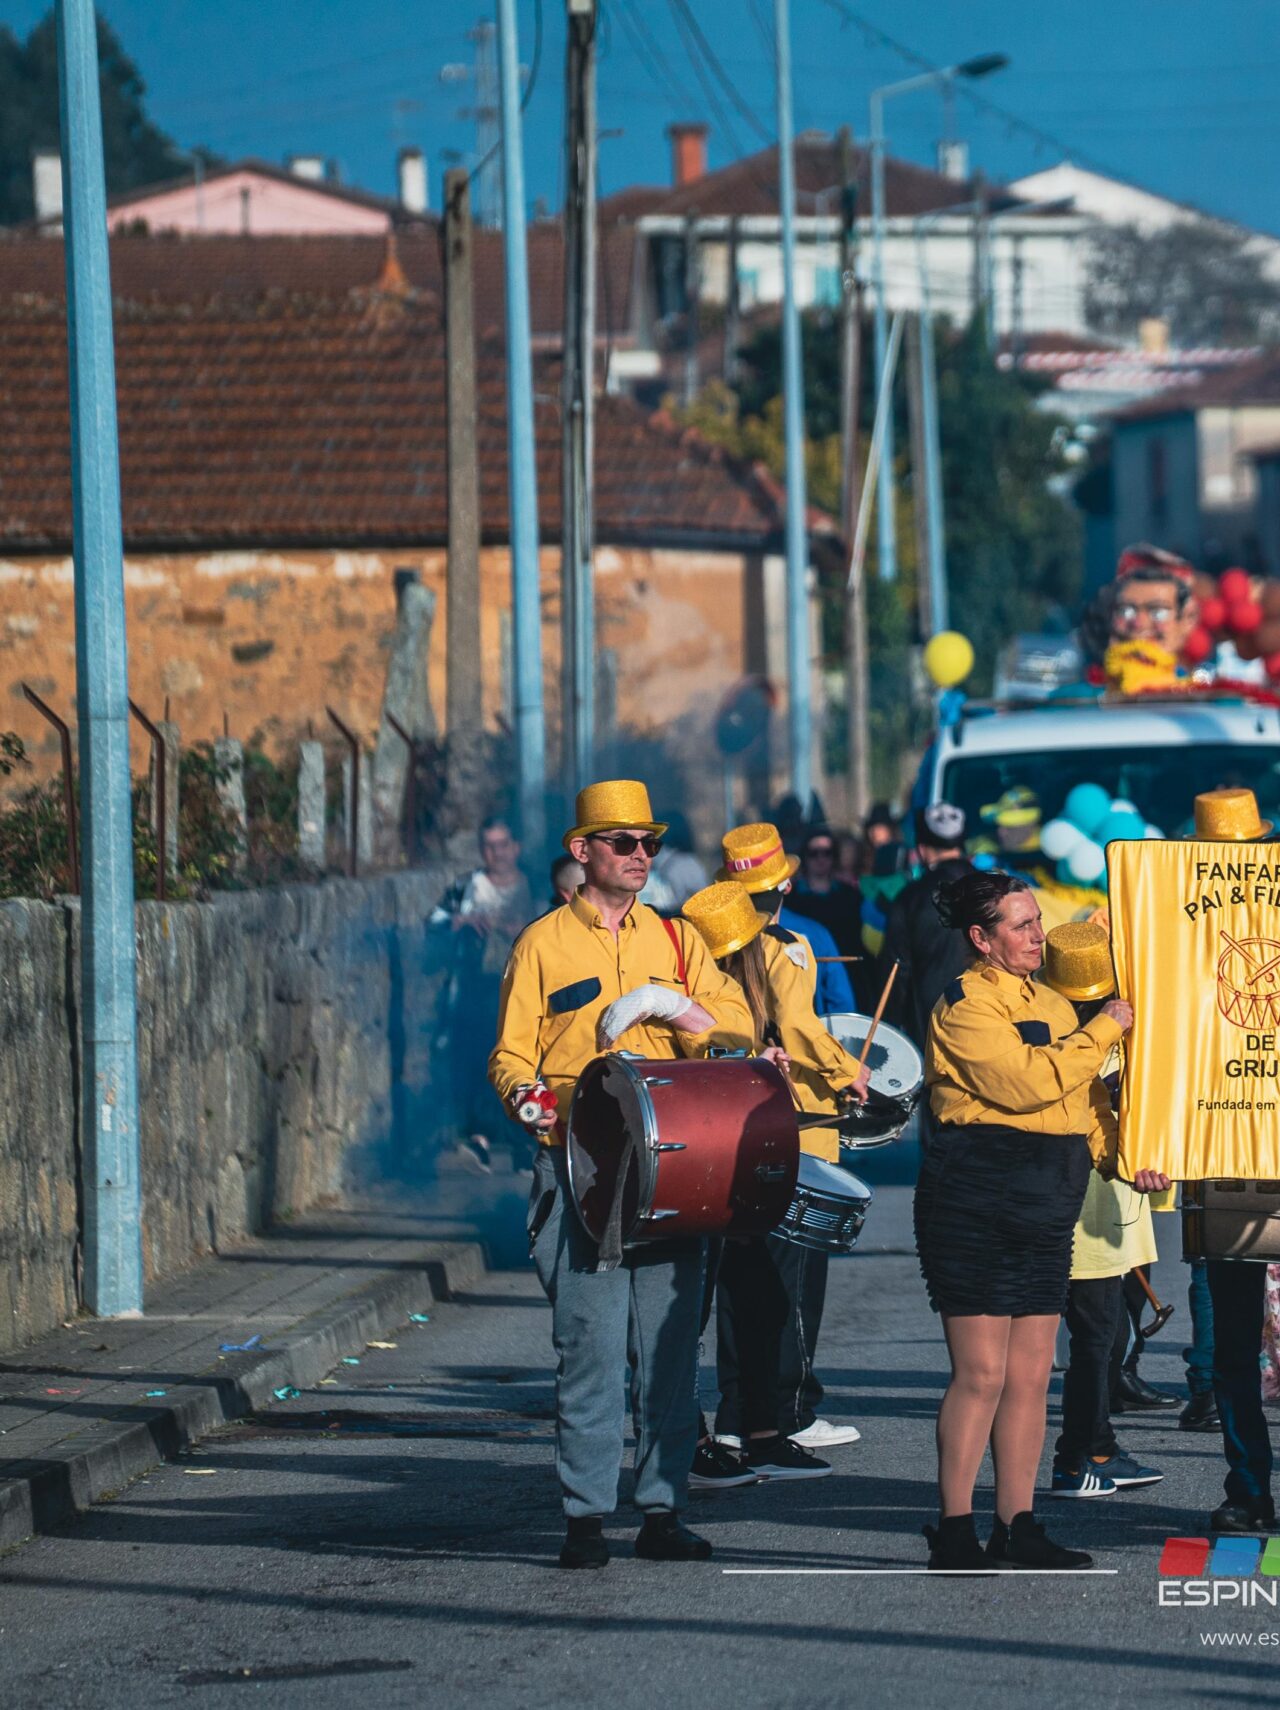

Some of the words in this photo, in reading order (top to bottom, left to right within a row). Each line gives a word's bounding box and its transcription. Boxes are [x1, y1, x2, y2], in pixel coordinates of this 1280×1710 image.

[1184, 891, 1223, 922] PAI
[1230, 886, 1246, 904] &
[1246, 1034, 1275, 1051] DE
[1197, 1098, 1252, 1111] Fundada
[1256, 1101, 1275, 1111] em
